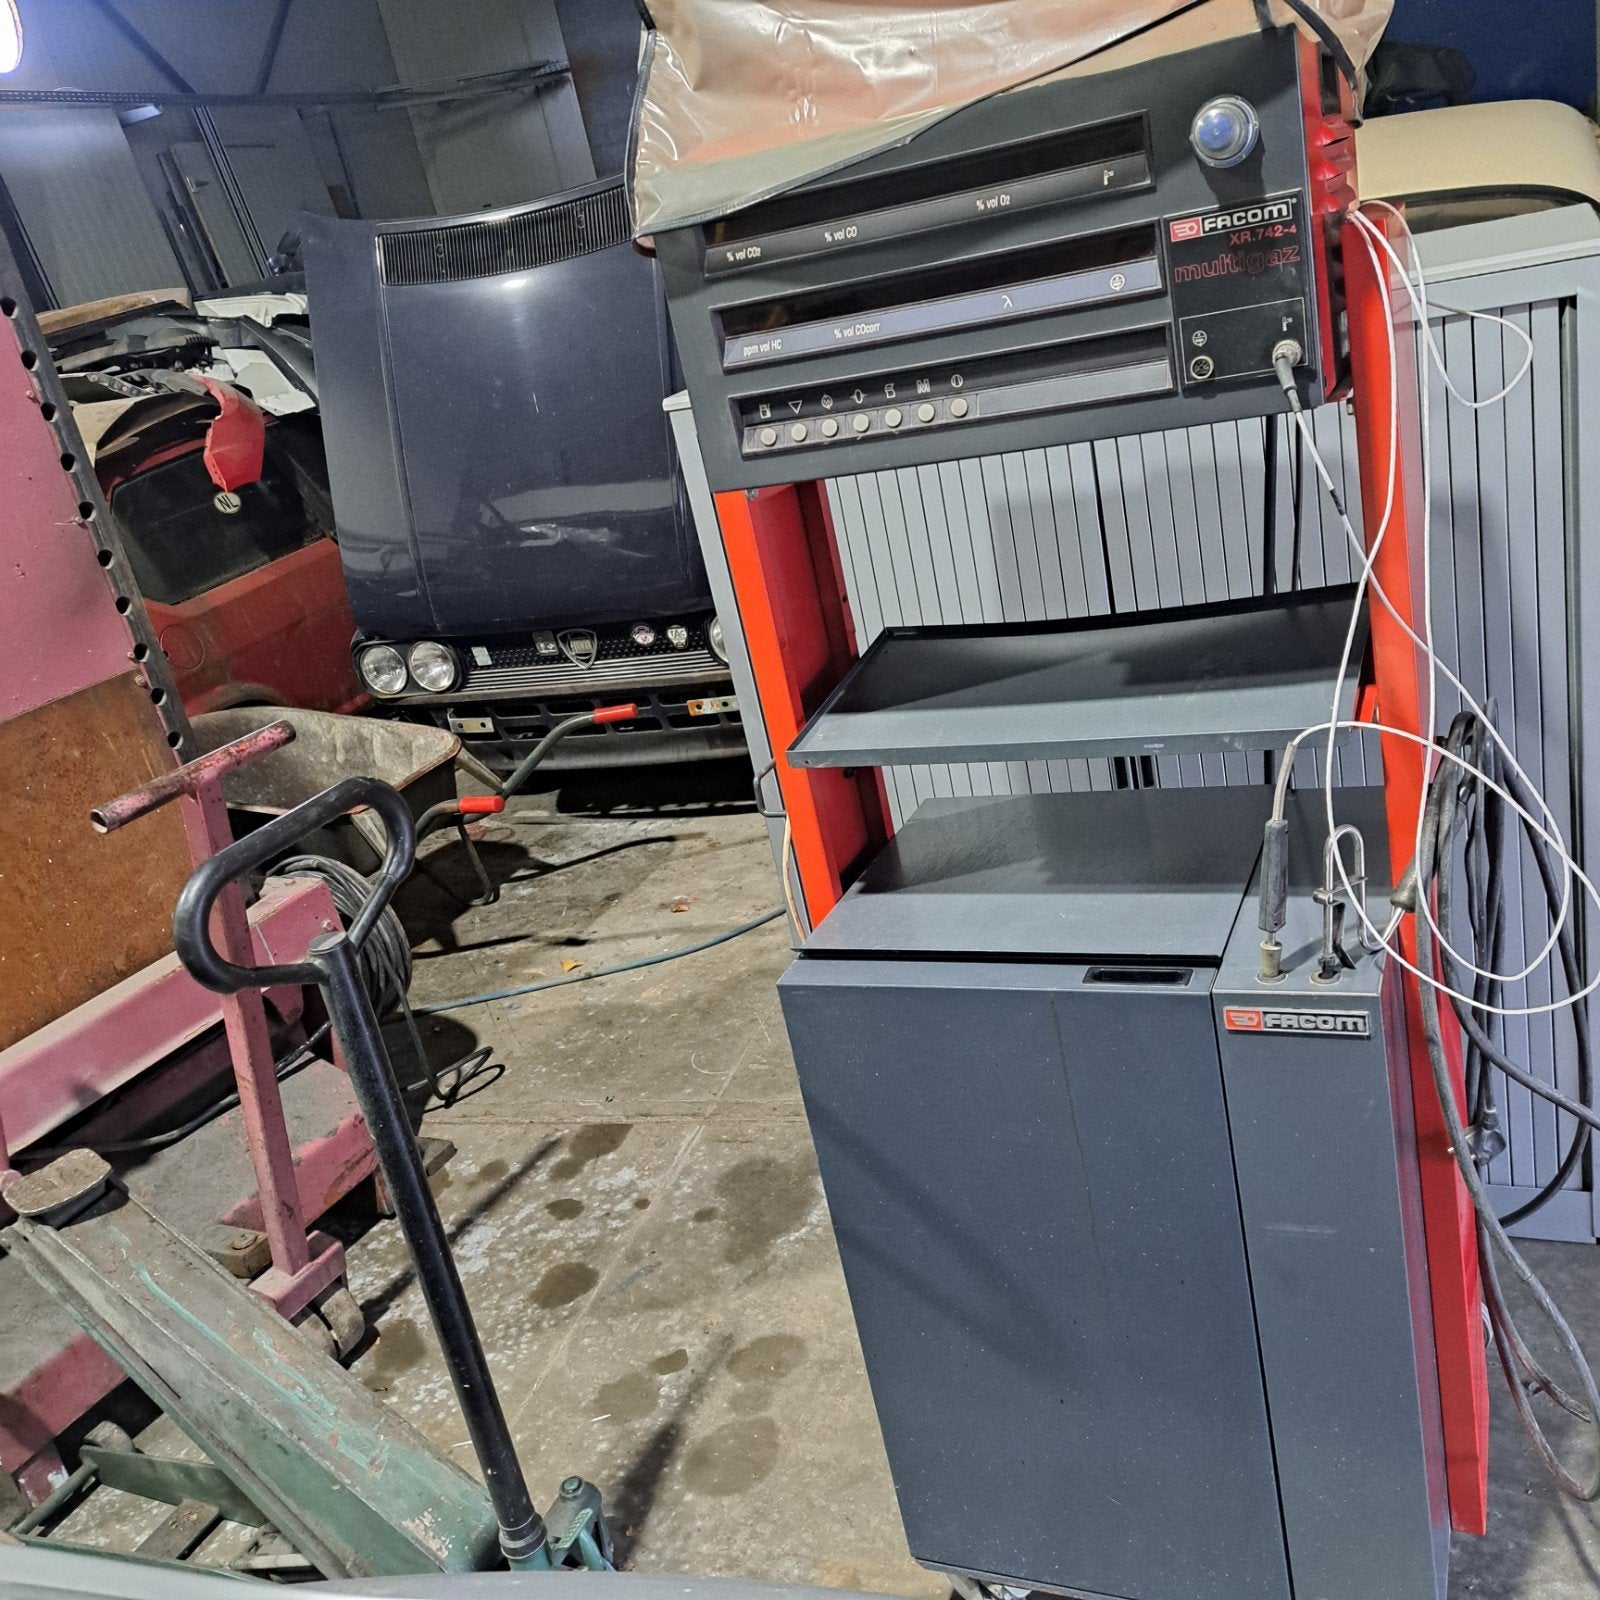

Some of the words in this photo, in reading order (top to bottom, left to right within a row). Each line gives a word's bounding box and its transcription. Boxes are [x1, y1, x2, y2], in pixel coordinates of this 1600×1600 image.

[986, 195, 999, 209] vol
[1203, 203, 1288, 232] FACOM
[833, 228, 845, 240] vol
[846, 226, 857, 238] CO
[735, 249, 746, 260] vol
[1175, 245, 1300, 283] multigaz
[843, 325, 854, 338] vol
[743, 345, 758, 357] ppm
[760, 341, 770, 353] vol
[771, 339, 782, 350] HC
[216, 494, 240, 511] NL
[1264, 1013, 1365, 1032] FACOM
